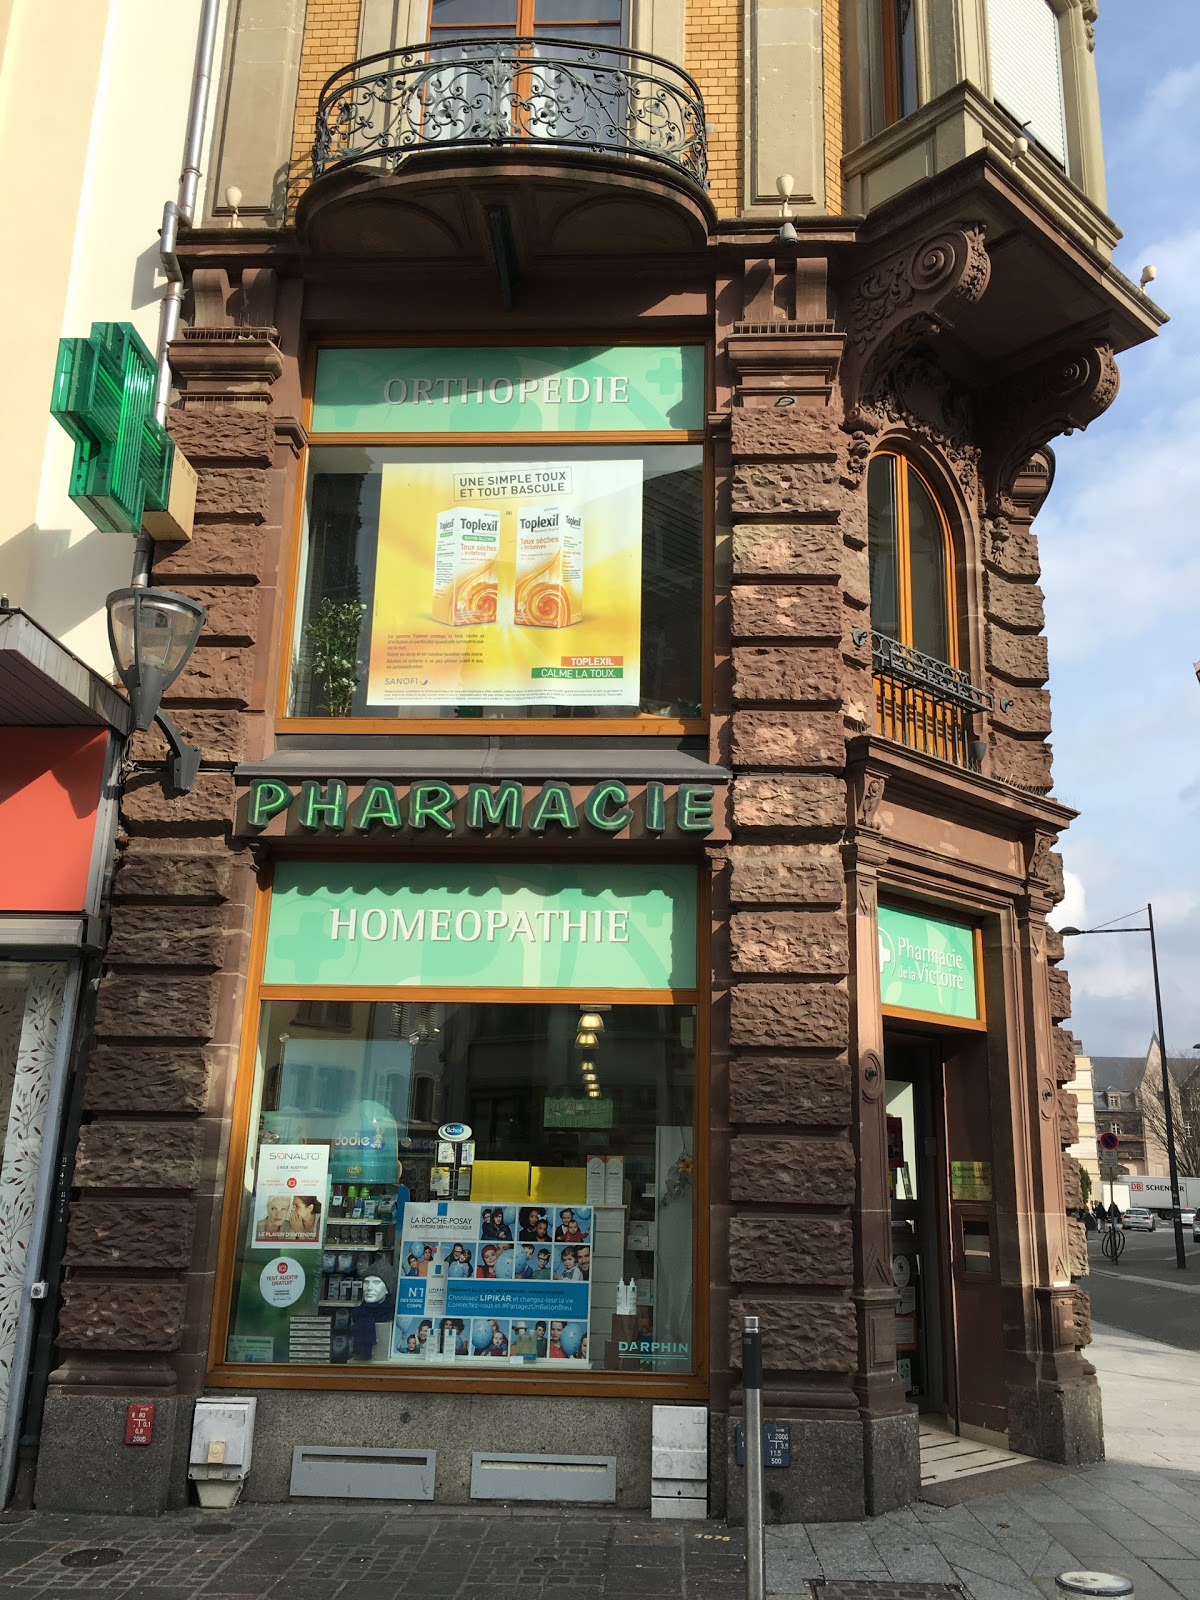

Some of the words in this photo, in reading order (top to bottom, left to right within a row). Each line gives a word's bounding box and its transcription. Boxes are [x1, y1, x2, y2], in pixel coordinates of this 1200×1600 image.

[383, 376, 630, 405] ORTHOPEDIE
[459, 477, 484, 487] UNE
[487, 474, 532, 485] SIMPLE
[535, 471, 566, 482] TOUX
[460, 488, 474, 498] ET
[477, 486, 507, 497] TOUT
[511, 482, 565, 495] BASCULE
[460, 518, 498, 534] Toplexil
[520, 513, 559, 532] Toplexil
[535, 536, 559, 544] sèches
[460, 543, 475, 551] Toux
[477, 544, 497, 552] sèches
[571, 657, 614, 666] TOPLEXIL
[541, 668, 573, 678] CALME
[575, 669, 588, 678] LA
[590, 669, 616, 678] TOUX.
[385, 677, 418, 685] SANOFI
[249, 779, 715, 832] PHARMACIE
[329, 908, 630, 943] HOMEOPATHIE
[897, 936, 963, 970] Pharmacie
[915, 961, 964, 990] Victoire
[269, 1152, 320, 1160] SONALTO
[1145, 1184, 1185, 1192] SCHENR
[421, 1217, 472, 1225] ROCHE-POSAY
[479, 1294, 512, 1302] LIPIKAR
[447, 1301, 493, 1309] Connectez-vous
[618, 1341, 688, 1353] DARPHIN
